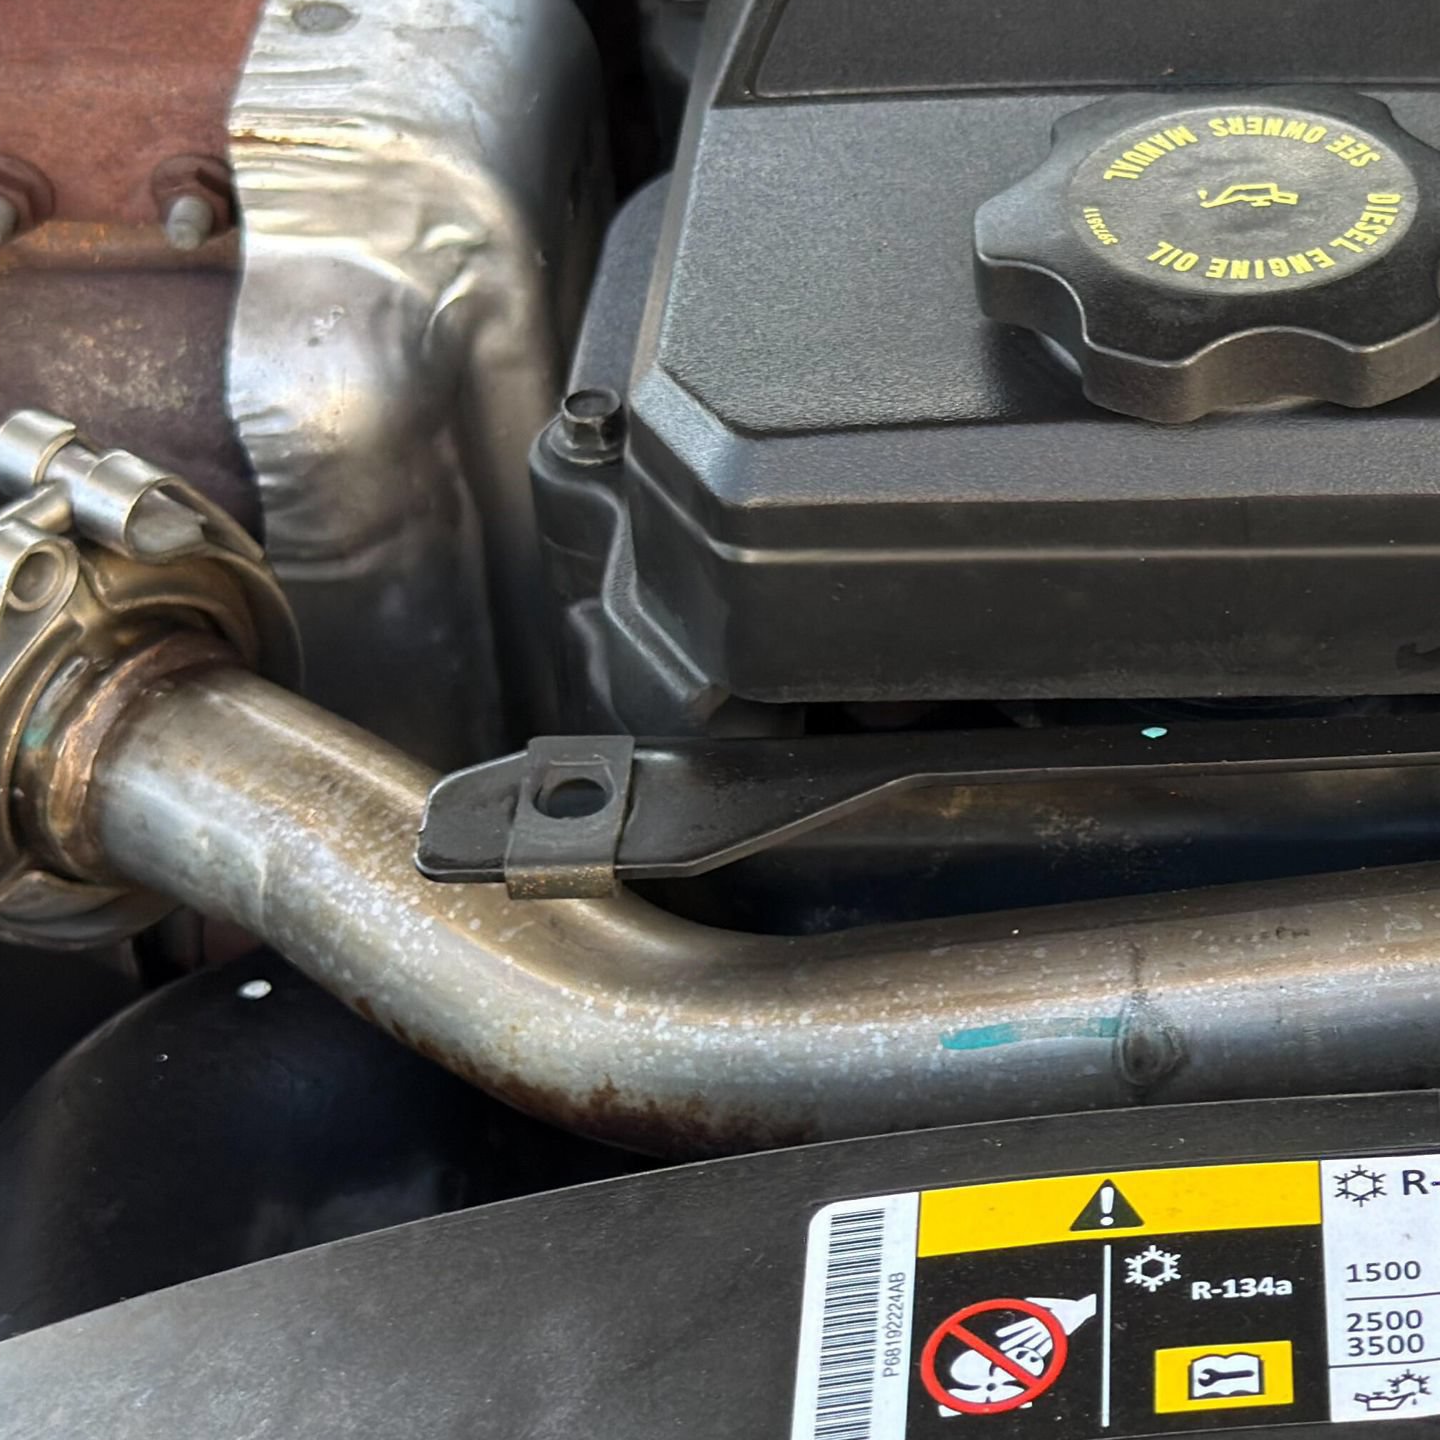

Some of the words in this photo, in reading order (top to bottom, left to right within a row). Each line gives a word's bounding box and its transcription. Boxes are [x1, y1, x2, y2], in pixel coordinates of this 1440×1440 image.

[1208, 116, 1328, 145] OWNERS
[1103, 125, 1198, 181] MANUAL
[1325, 133, 1381, 168] SEE
[1329, 193, 1403, 254] DIESEL
[1146, 241, 1200, 273] OIL
[1205, 247, 1337, 280] ENGINE
[1345, 1260, 1422, 1284] 1500
[1191, 1276, 1294, 1301] R-134a
[883, 1271, 907, 1379] P68192224AB
[1346, 1309, 1424, 1333] 2500
[1347, 1333, 1425, 1357] 3500
